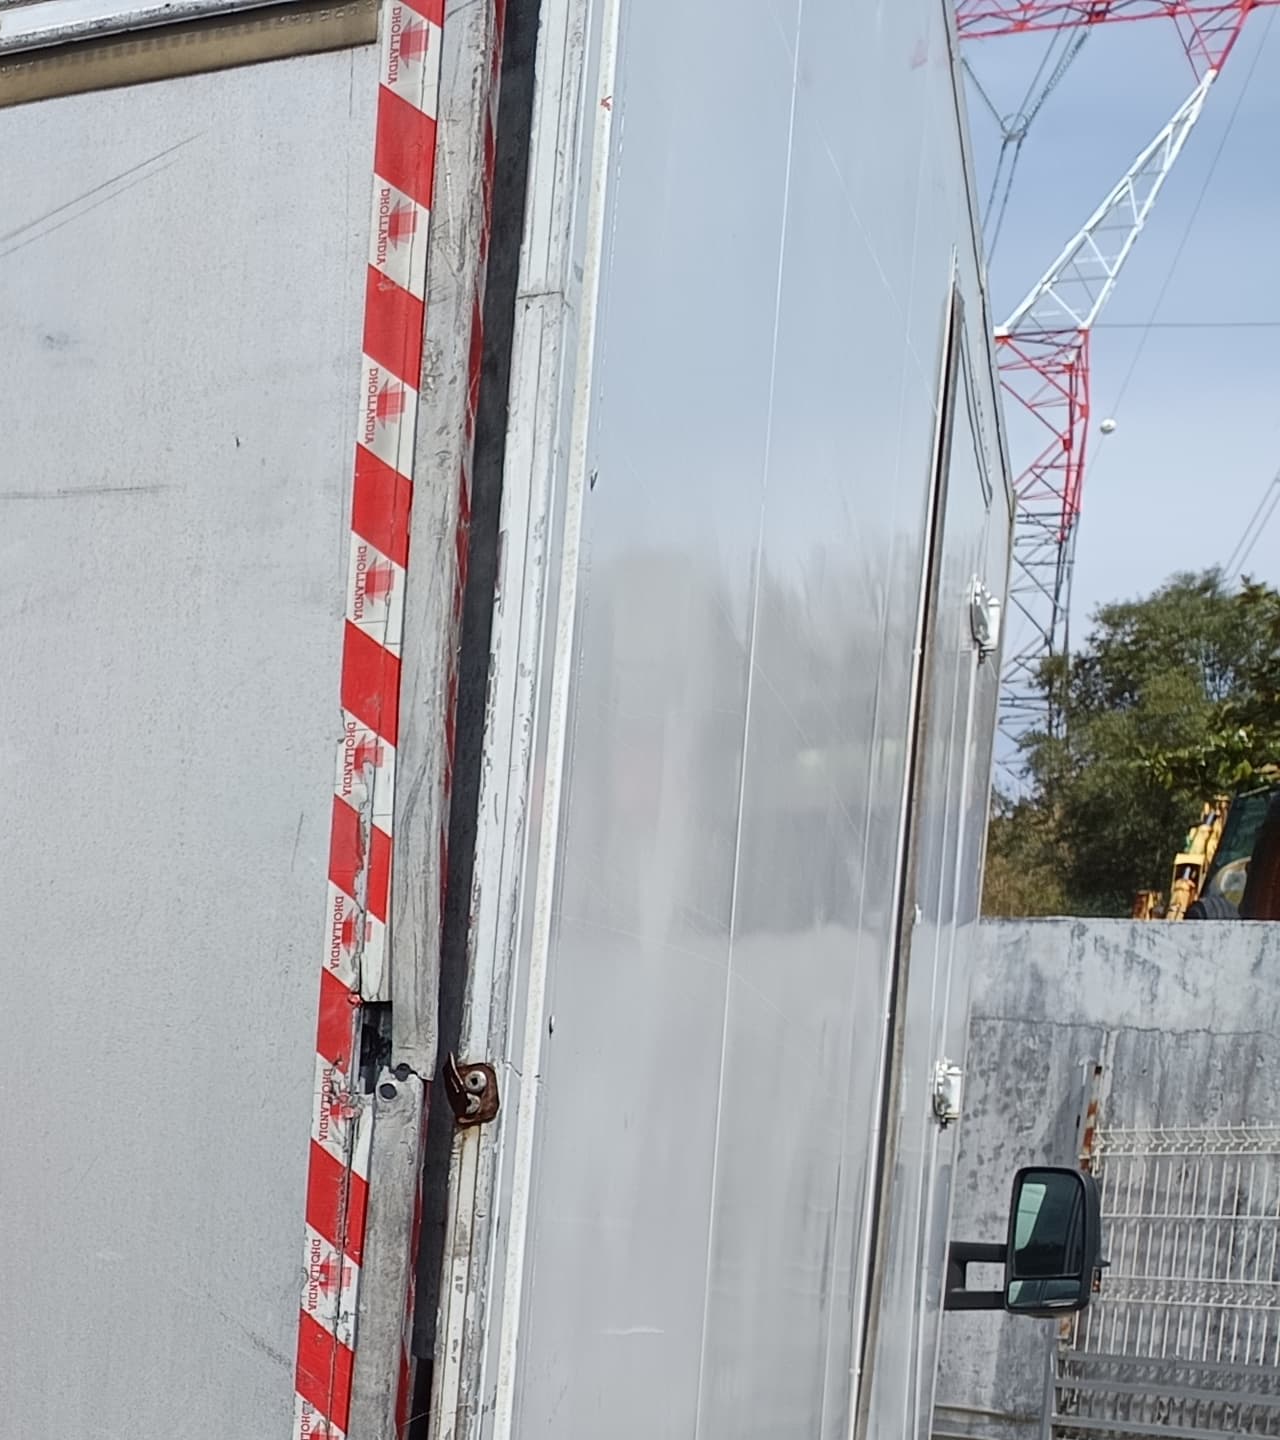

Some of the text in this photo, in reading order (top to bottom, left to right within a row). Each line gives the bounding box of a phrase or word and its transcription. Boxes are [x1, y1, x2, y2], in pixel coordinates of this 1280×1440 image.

[388, 6, 402, 85] DHOLLANDIA
[376, 188, 390, 265] DHOLLANDIA
[365, 367, 379, 444] DHOLLANDIA
[354, 545, 367, 621] DHOLLANDIA
[342, 722, 356, 797] DHOLLANDIA
[330, 896, 344, 969] DHOLLANDIA
[308, 1239, 322, 1310] DHOLLANDIA
